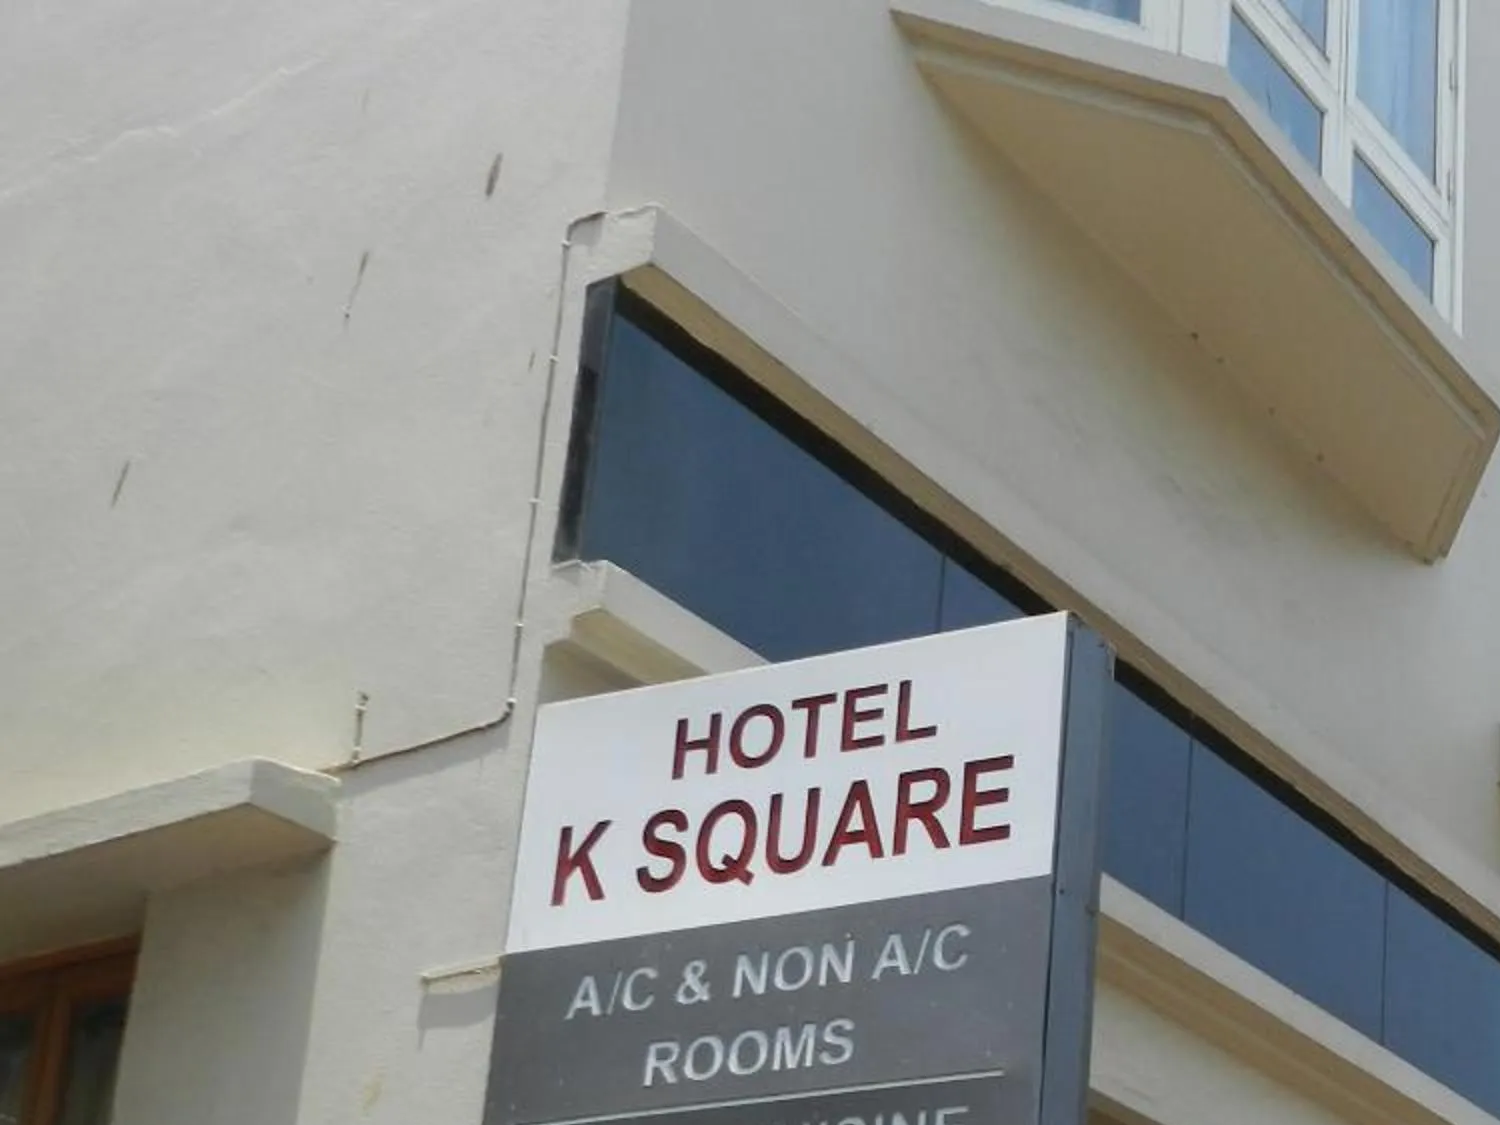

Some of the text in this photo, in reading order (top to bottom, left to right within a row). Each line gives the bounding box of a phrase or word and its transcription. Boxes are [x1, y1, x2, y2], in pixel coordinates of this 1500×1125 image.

[671, 680, 937, 780] HOTEL
[551, 755, 1015, 906] K SQUARE
[566, 924, 970, 1021] A/C & NON A/C
[643, 1019, 855, 1087] ROOMS
